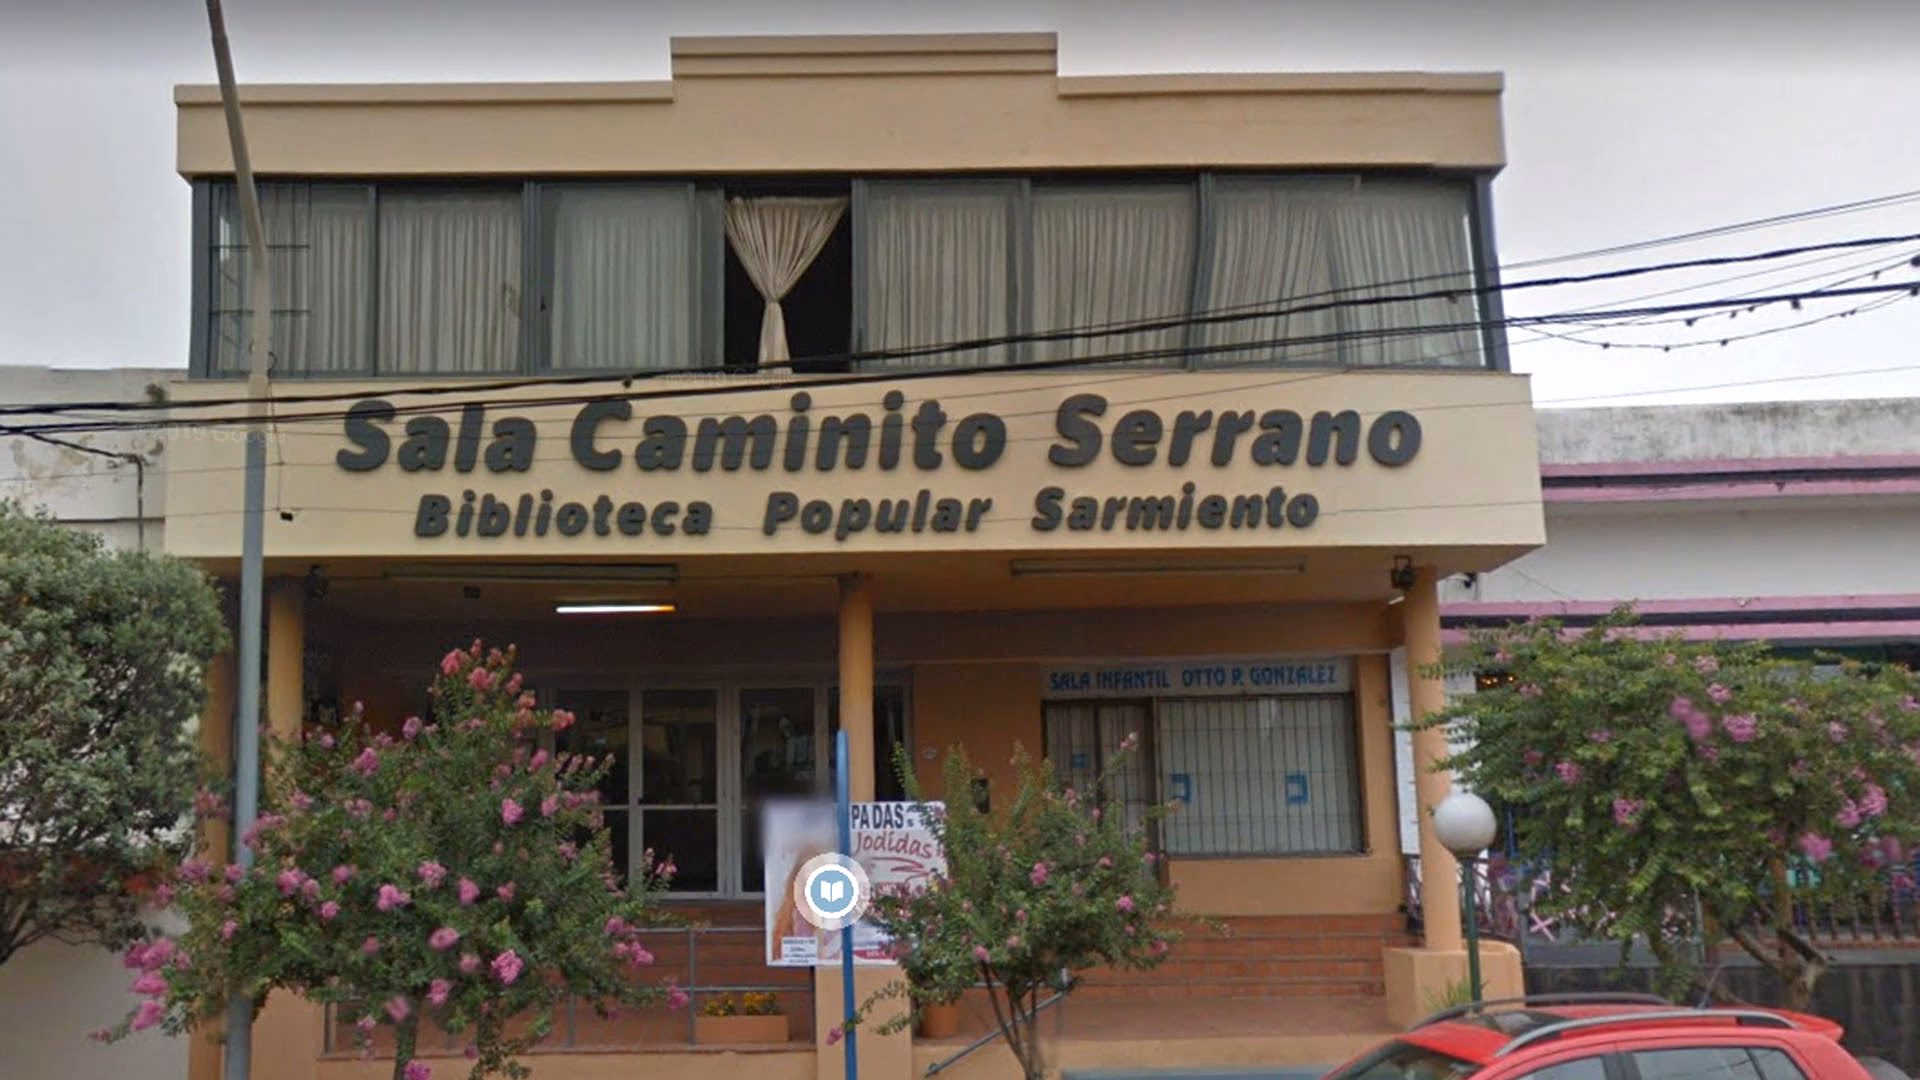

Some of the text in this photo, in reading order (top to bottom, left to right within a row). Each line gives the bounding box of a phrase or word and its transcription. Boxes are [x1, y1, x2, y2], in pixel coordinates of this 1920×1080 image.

[336, 390, 1422, 473] Sala Caminito Serrano
[414, 481, 1320, 542] Biblioteca Popular Sarmiento
[1050, 670, 1090, 691] SALA
[1097, 669, 1171, 690] INFANTIL
[1182, 666, 1225, 687] OTTO
[1250, 663, 1338, 686] GONZALEZ
